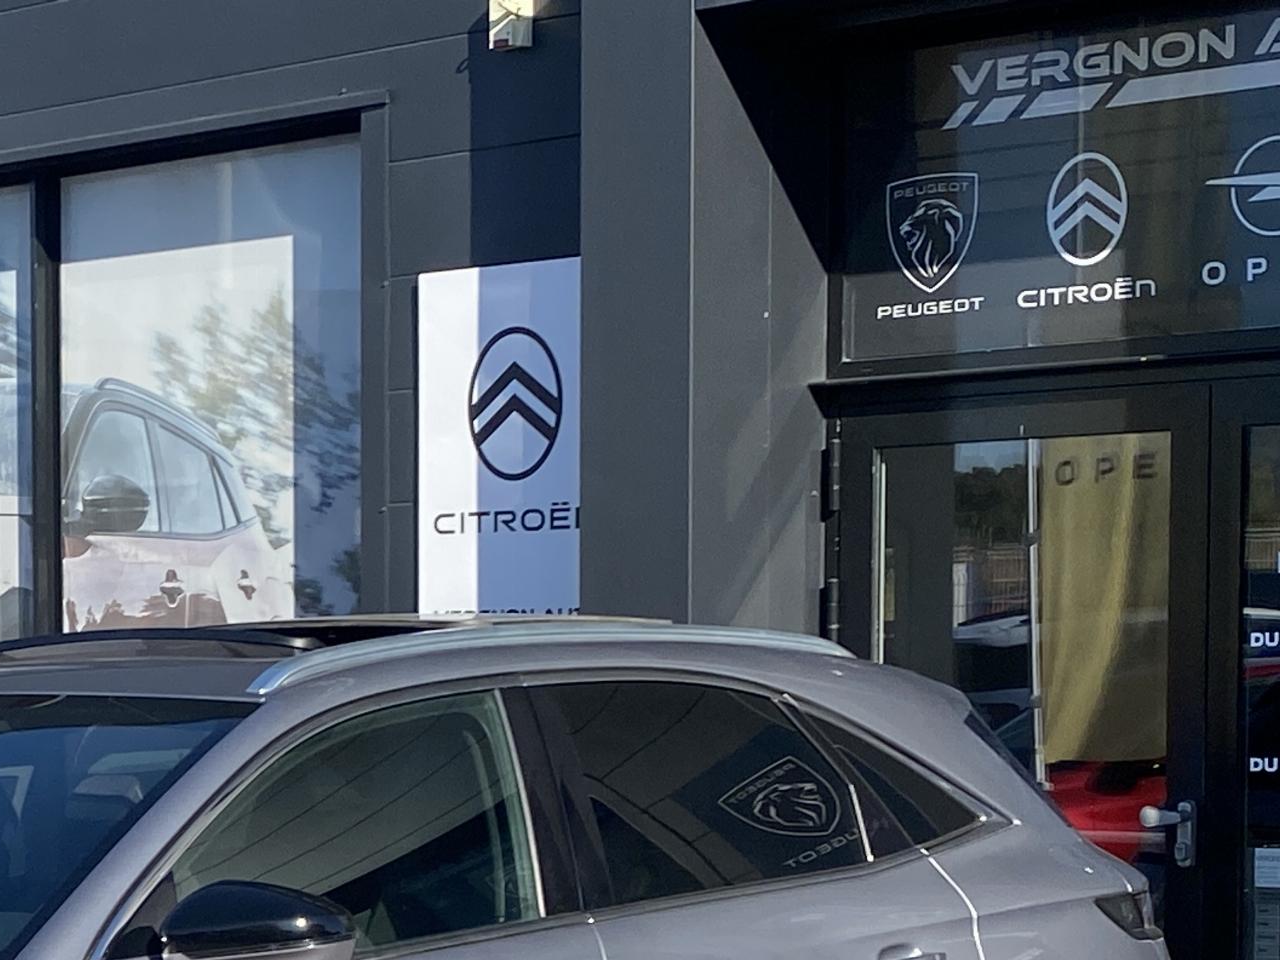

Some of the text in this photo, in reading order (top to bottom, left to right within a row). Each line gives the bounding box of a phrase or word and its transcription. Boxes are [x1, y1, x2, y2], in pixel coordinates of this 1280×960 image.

[950, 24, 1235, 95] VERGNON
[893, 182, 969, 199] PEUGEOT
[876, 297, 985, 319] PEUGEOT
[434, 501, 580, 534] CITROË
